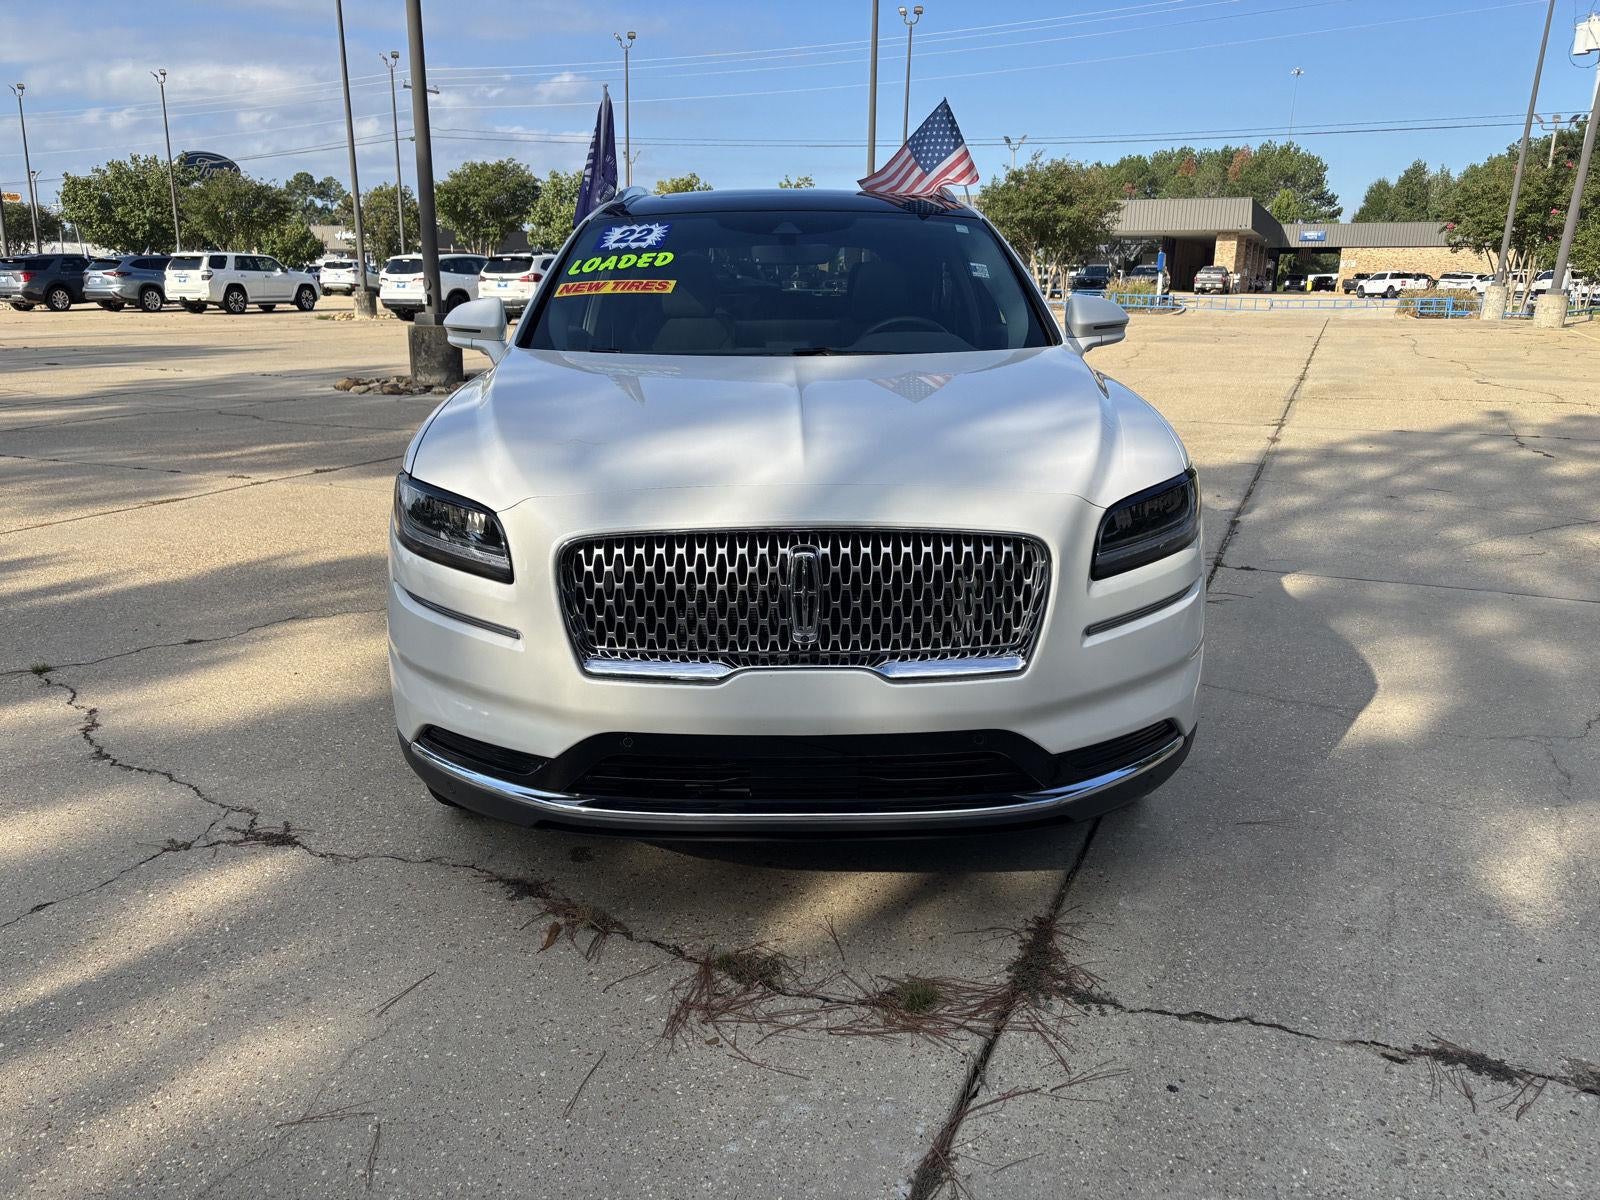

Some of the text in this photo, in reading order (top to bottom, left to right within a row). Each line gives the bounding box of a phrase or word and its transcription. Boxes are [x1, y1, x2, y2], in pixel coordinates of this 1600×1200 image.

[613, 228, 654, 244] 22
[567, 251, 675, 276] LOADED
[559, 280, 671, 295] NEW TIRES
